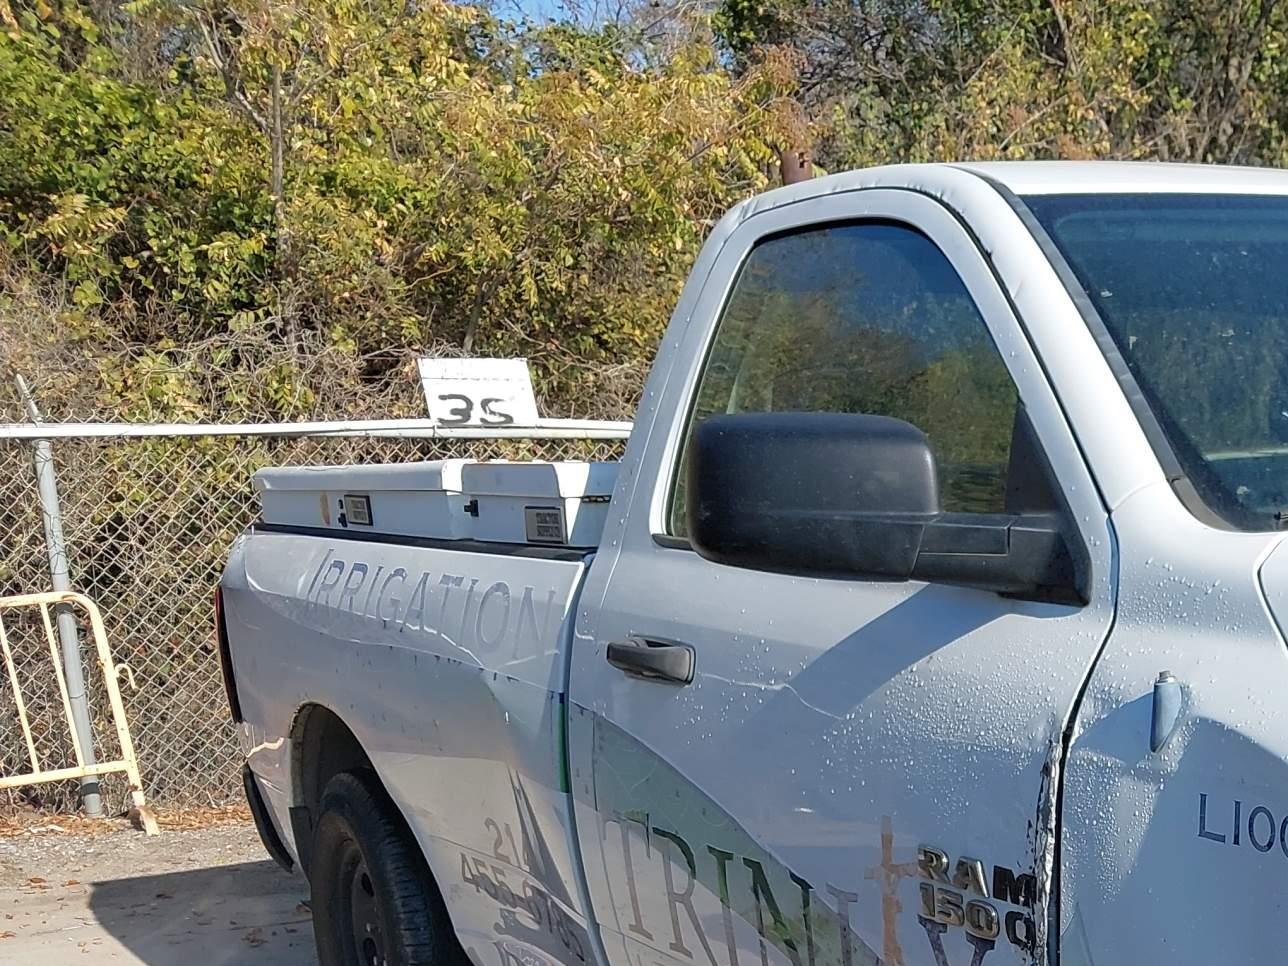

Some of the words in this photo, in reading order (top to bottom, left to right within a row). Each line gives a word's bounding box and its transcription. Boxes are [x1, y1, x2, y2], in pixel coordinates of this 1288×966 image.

[306, 548, 557, 660] IRRIGATION
[918, 845, 1037, 909] RAM
[918, 881, 1037, 950] 1500
